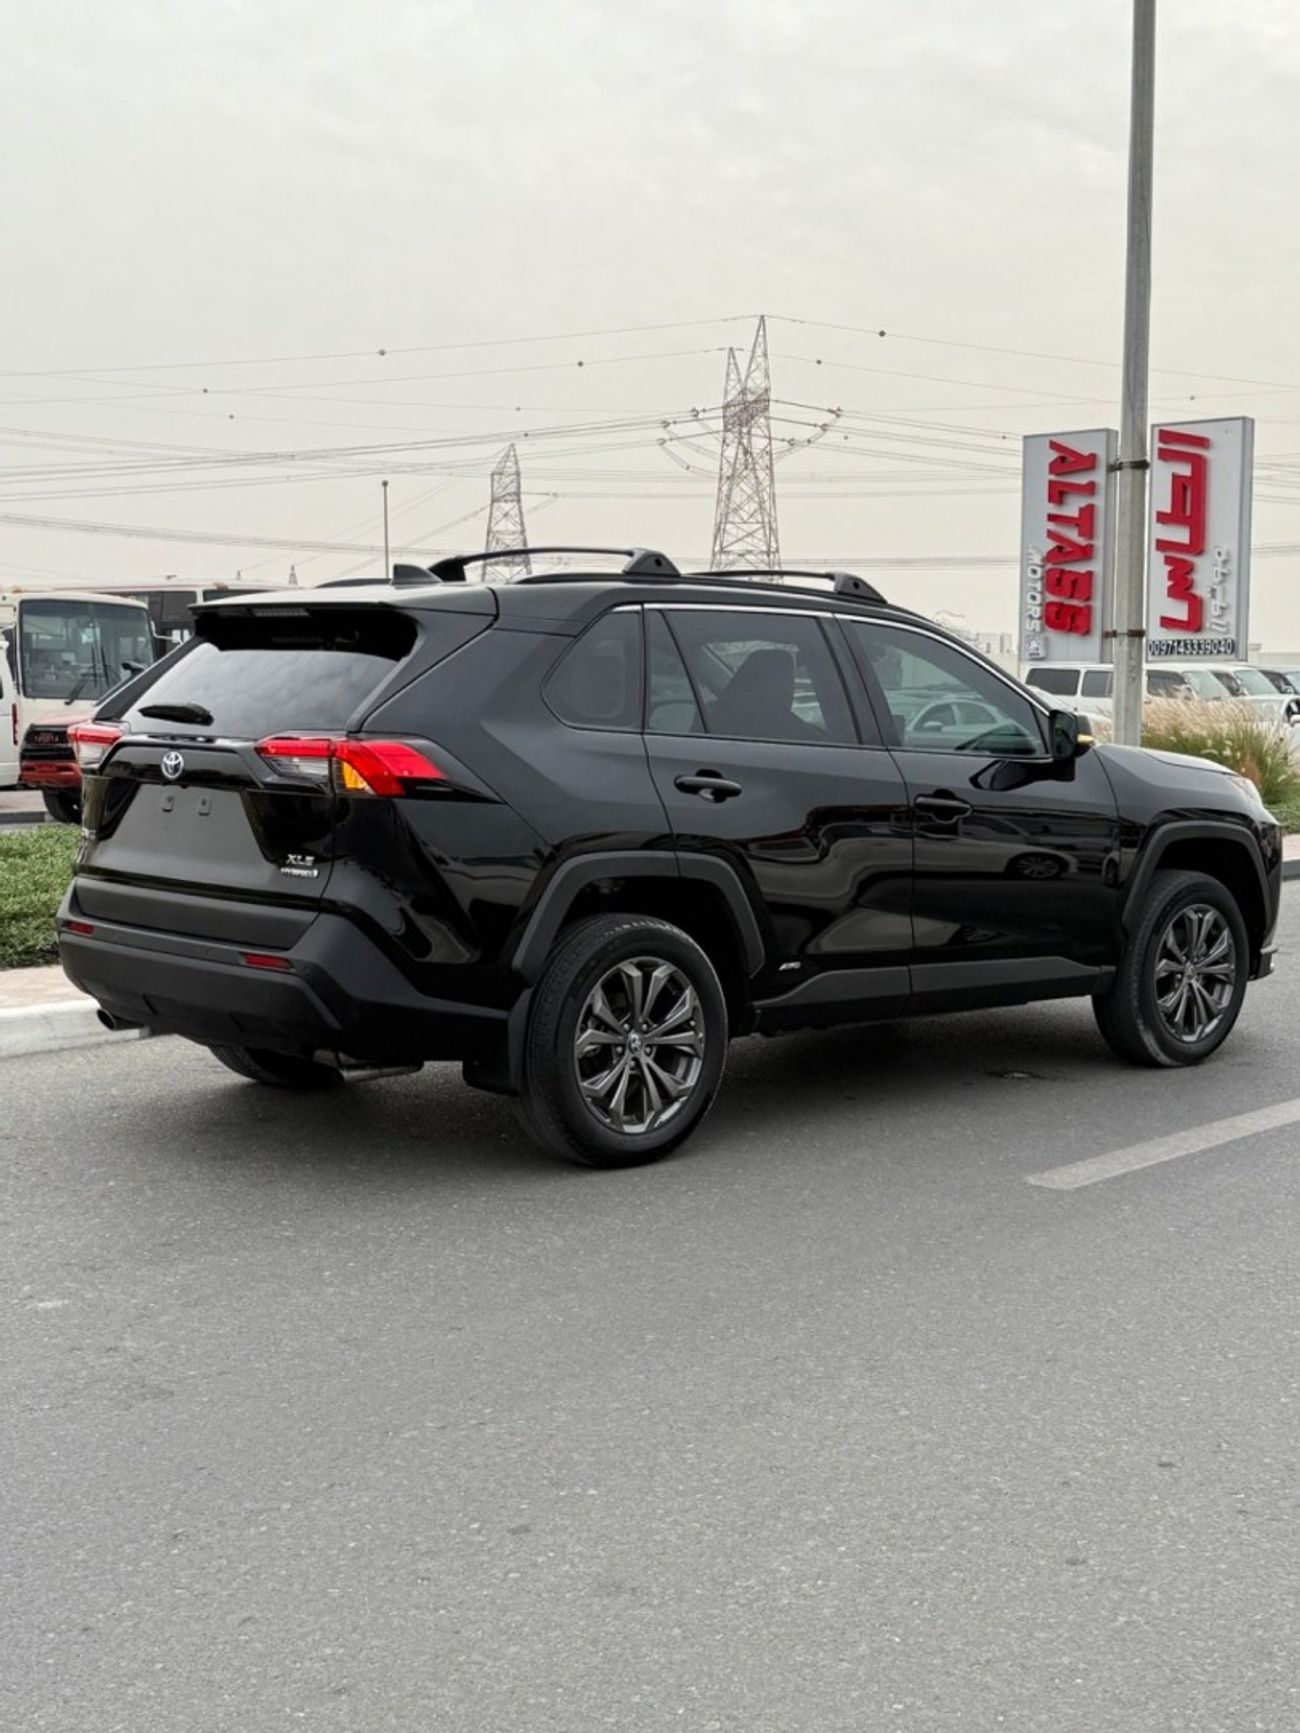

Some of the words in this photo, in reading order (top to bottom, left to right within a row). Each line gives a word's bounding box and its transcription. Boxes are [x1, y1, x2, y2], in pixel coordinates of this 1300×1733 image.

[1026, 545, 1043, 632] MOTORS
[1042, 440, 1097, 636] ALTASS
[1155, 429, 1210, 633] الطاس
[286, 854, 315, 866] XLE
